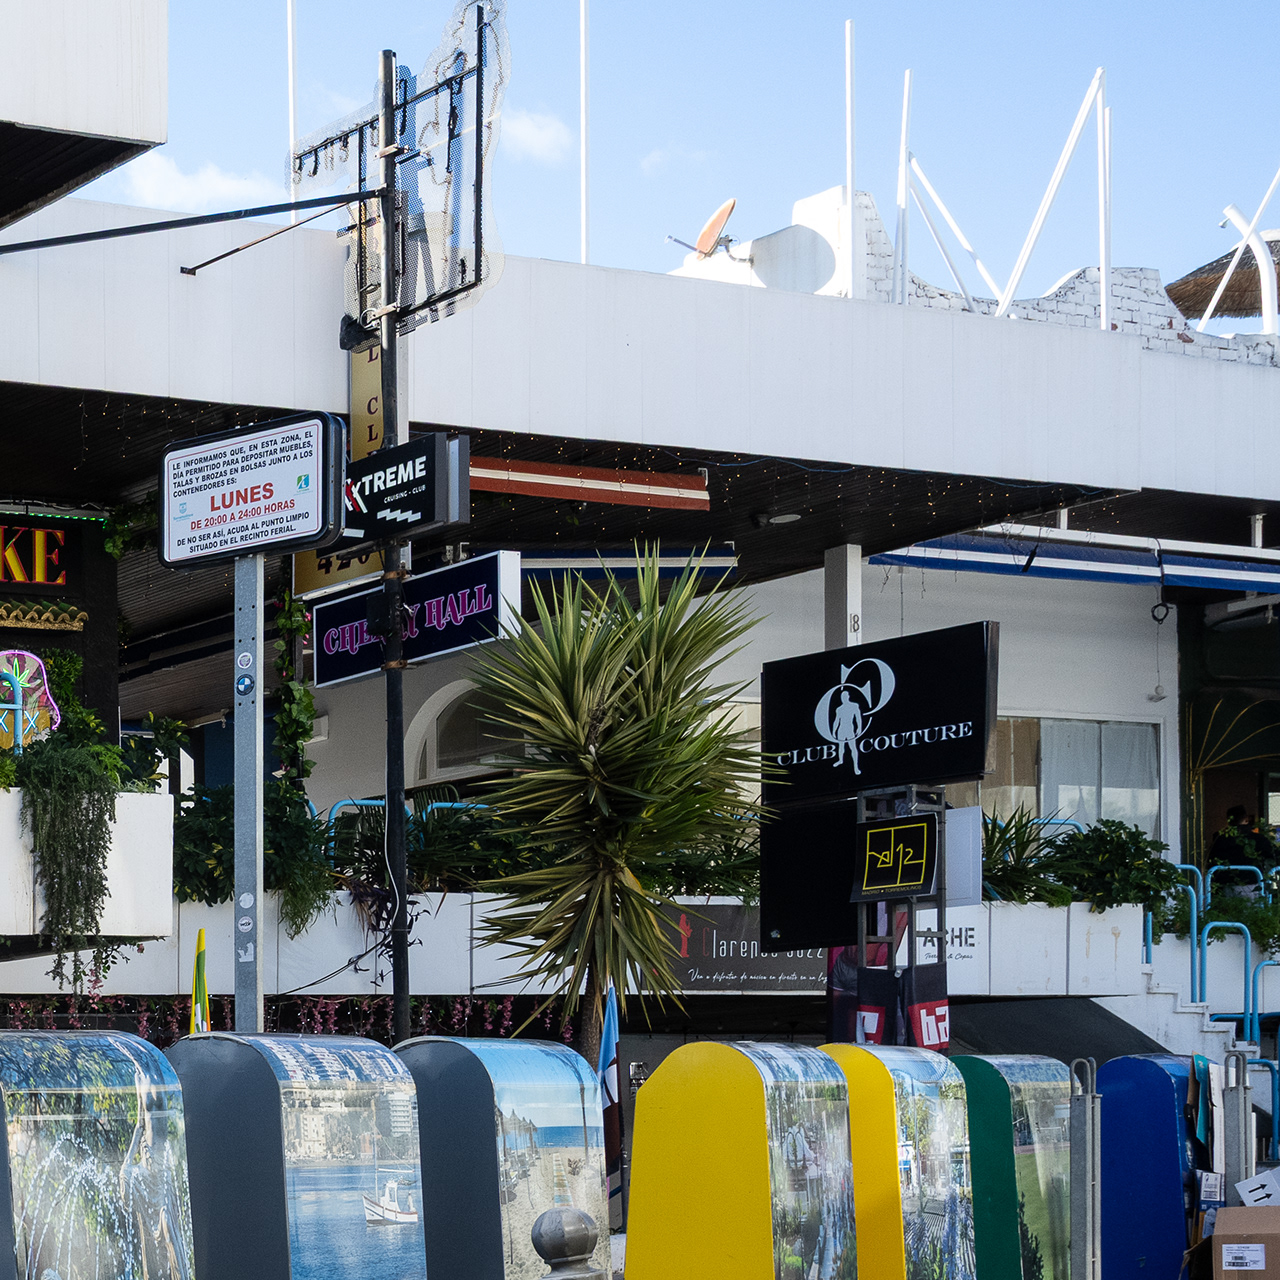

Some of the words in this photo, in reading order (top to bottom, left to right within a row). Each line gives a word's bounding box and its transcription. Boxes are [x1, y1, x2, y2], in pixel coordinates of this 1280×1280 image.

[173, 470, 184, 479] DÍA
[186, 462, 220, 477] PERMITIDO
[223, 458, 239, 469] PARA
[241, 449, 277, 464] DEPOSITAR
[279, 441, 313, 454] MUEBLES,
[183, 452, 227, 468] INFORMAMOS
[230, 447, 246, 457] QUE,
[249, 444, 258, 452] EN
[261, 440, 278, 449] ESTA
[281, 434, 301, 444] ZONA,
[173, 478, 193, 488] TALAS
[202, 470, 227, 481] BROZAS
[230, 467, 238, 475] EN
[241, 461, 266, 472] BOLSAS
[268, 455, 290, 466] JUNTO
[300, 450, 313, 458] LOS
[173, 480, 225, 498] CONTENEDORES
[210, 482, 274, 512] LUNES
[383, 490, 408, 504] CRUISING
[412, 484, 426, 494] CLUB
[177, 538, 185, 546] DE
[187, 535, 196, 543] NO
[199, 533, 210, 542] SER
[227, 525, 249, 535] ACUDA
[261, 517, 284, 528] PUNTO
[286, 512, 309, 523] LIMPIO
[191, 520, 202, 530] DE
[204, 514, 227, 526] 20:00
[230, 512, 236, 521] A
[238, 506, 261, 519] 24:00
[264, 499, 295, 514] HORAS
[190, 541, 218, 553] SITUADO
[240, 530, 269, 542] RECINTO
[323, 603, 421, 655] CHEY
[424, 583, 493, 631] HALL
[777, 744, 837, 766] CLUB
[859, 721, 973, 753] COUTURE
[702, 926, 779, 959] Claren
